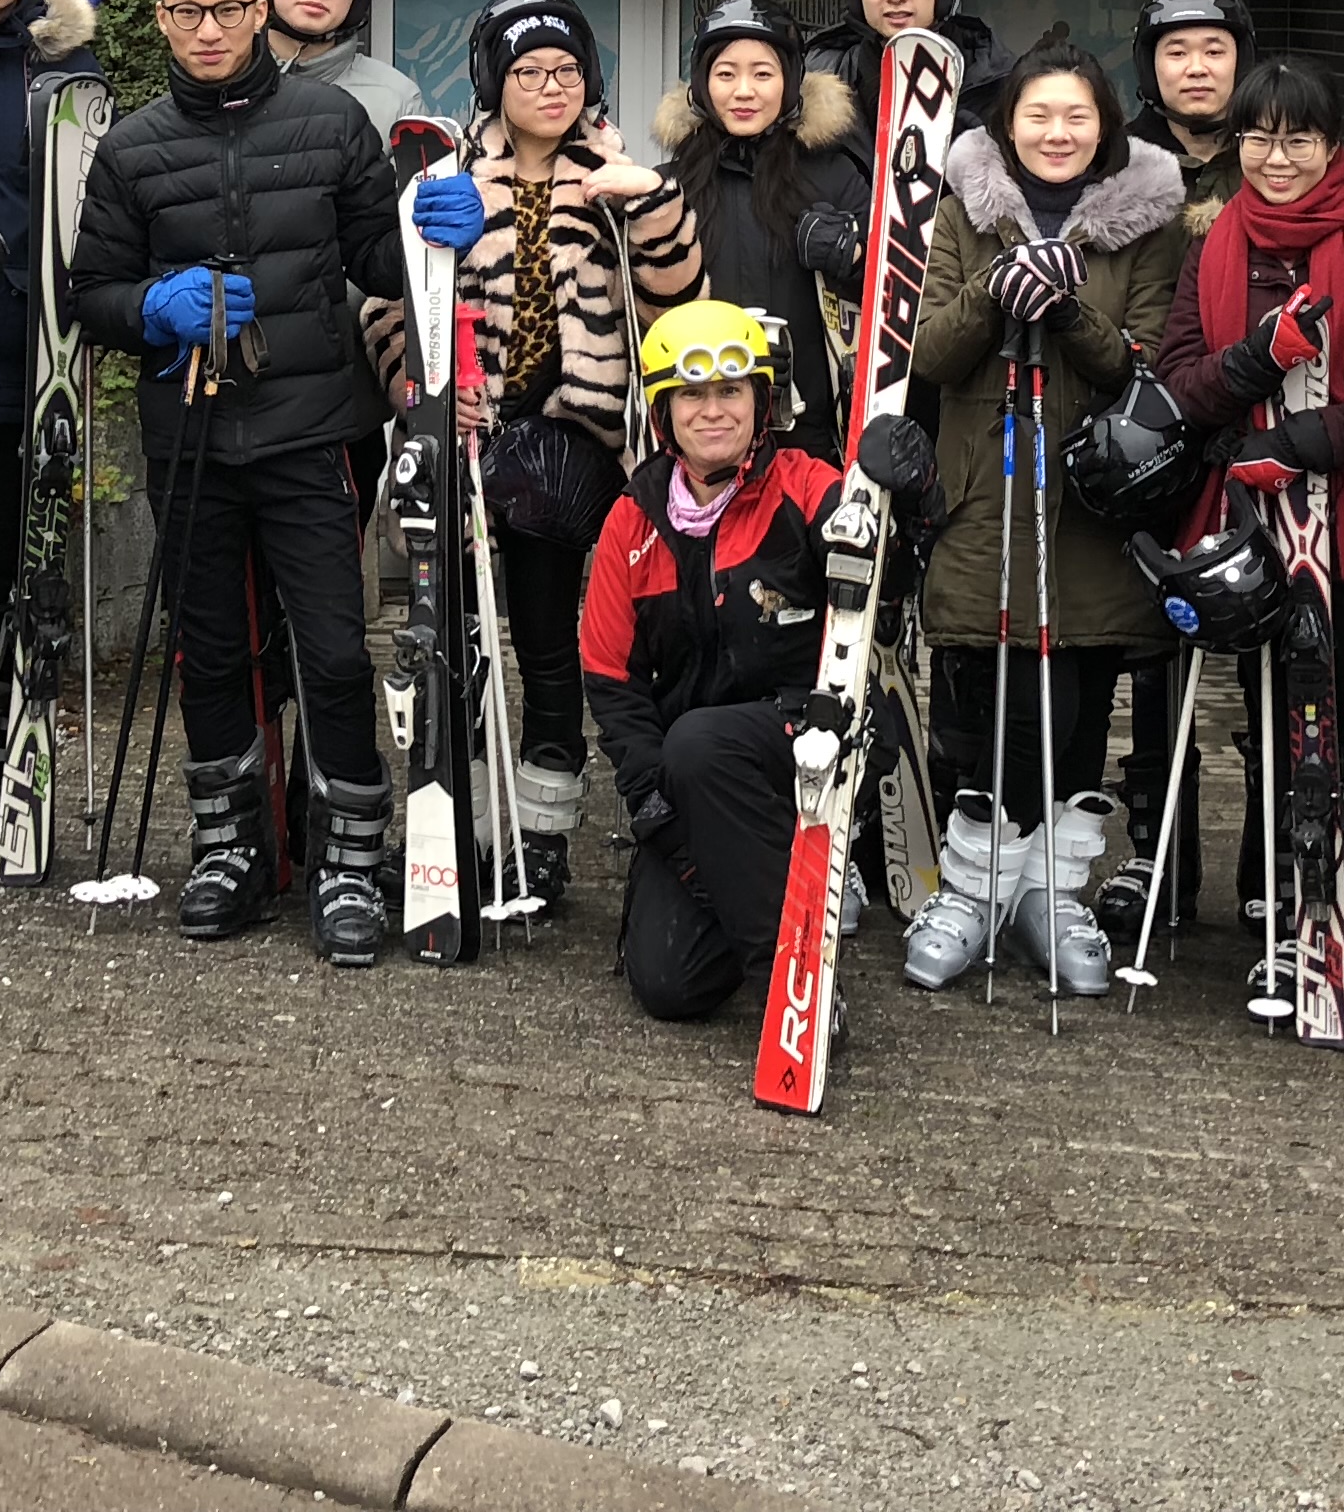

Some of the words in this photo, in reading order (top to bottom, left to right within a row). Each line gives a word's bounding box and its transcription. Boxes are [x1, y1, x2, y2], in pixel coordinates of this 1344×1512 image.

[410, 863, 459, 888] P100
[879, 774, 912, 908] OMIC
[779, 956, 814, 1065] RC
